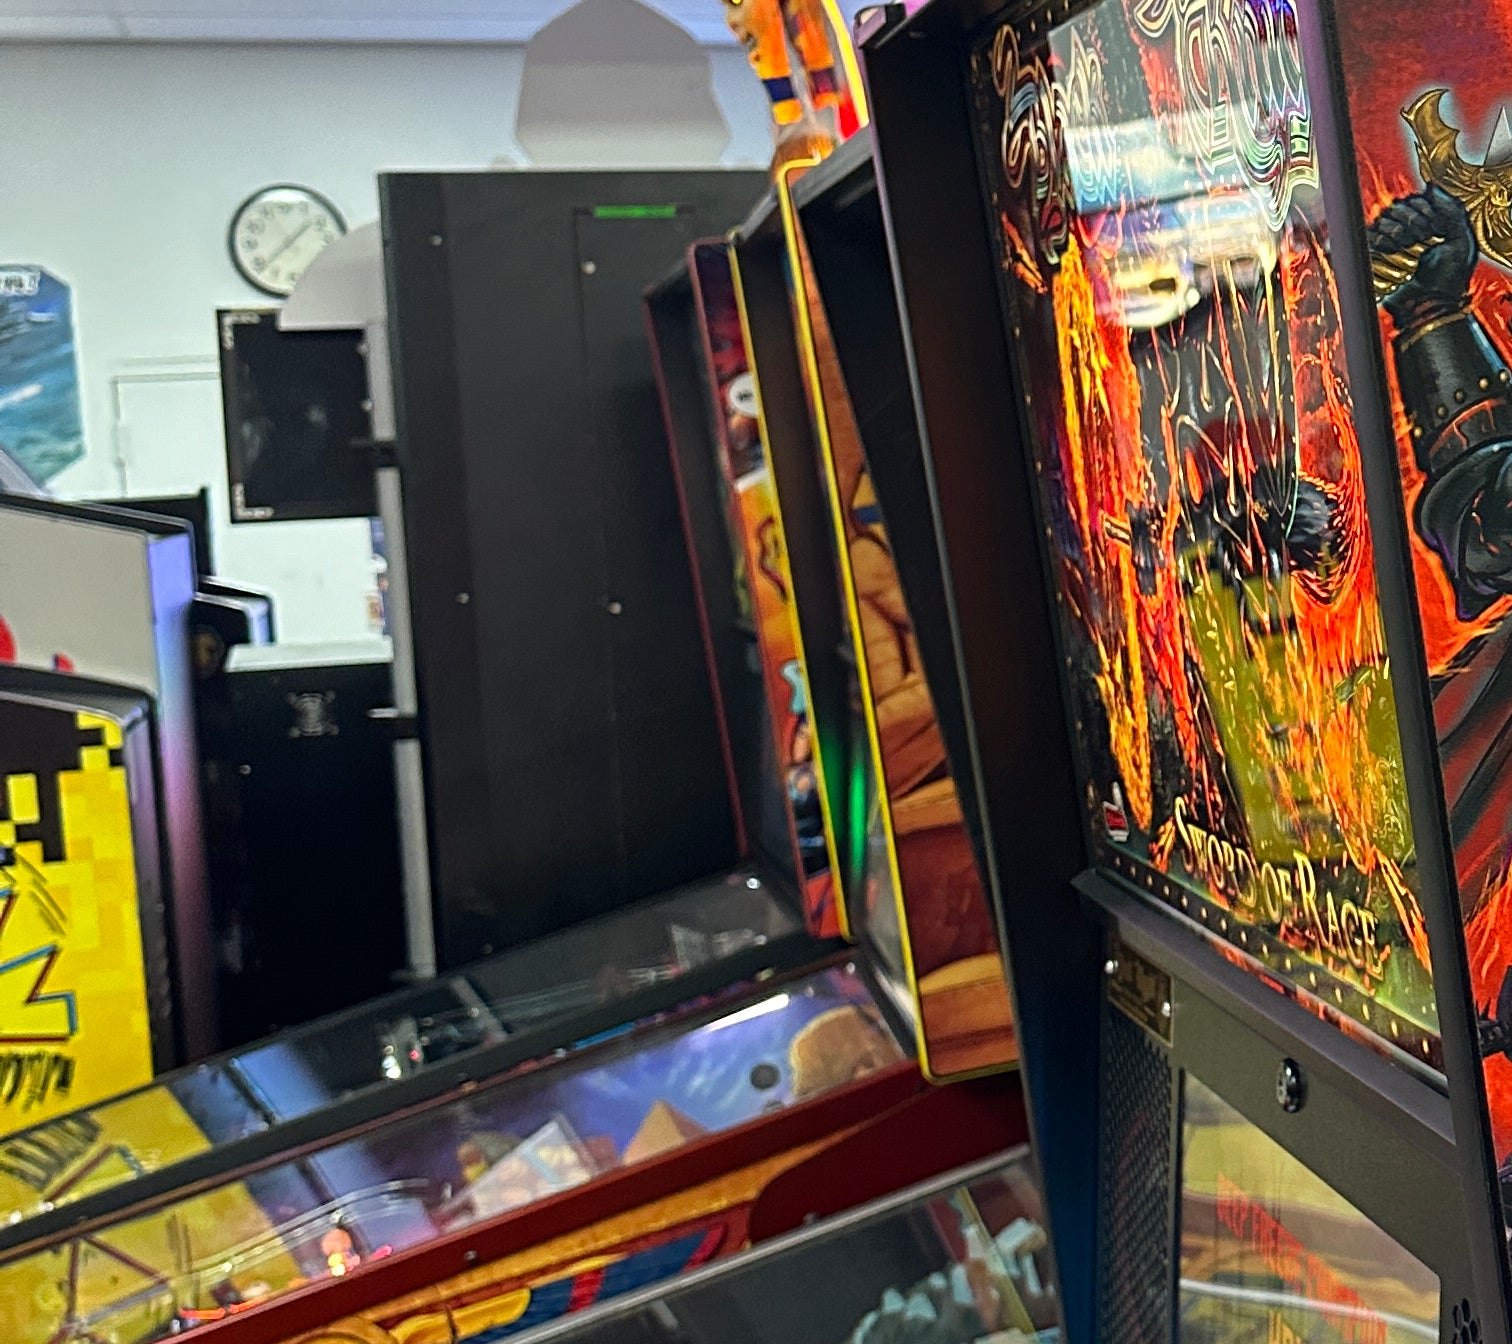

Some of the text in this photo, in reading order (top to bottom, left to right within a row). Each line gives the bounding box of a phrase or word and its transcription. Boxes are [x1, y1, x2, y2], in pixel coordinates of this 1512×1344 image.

[1174, 796, 1384, 981] SWORD OF RAGE
